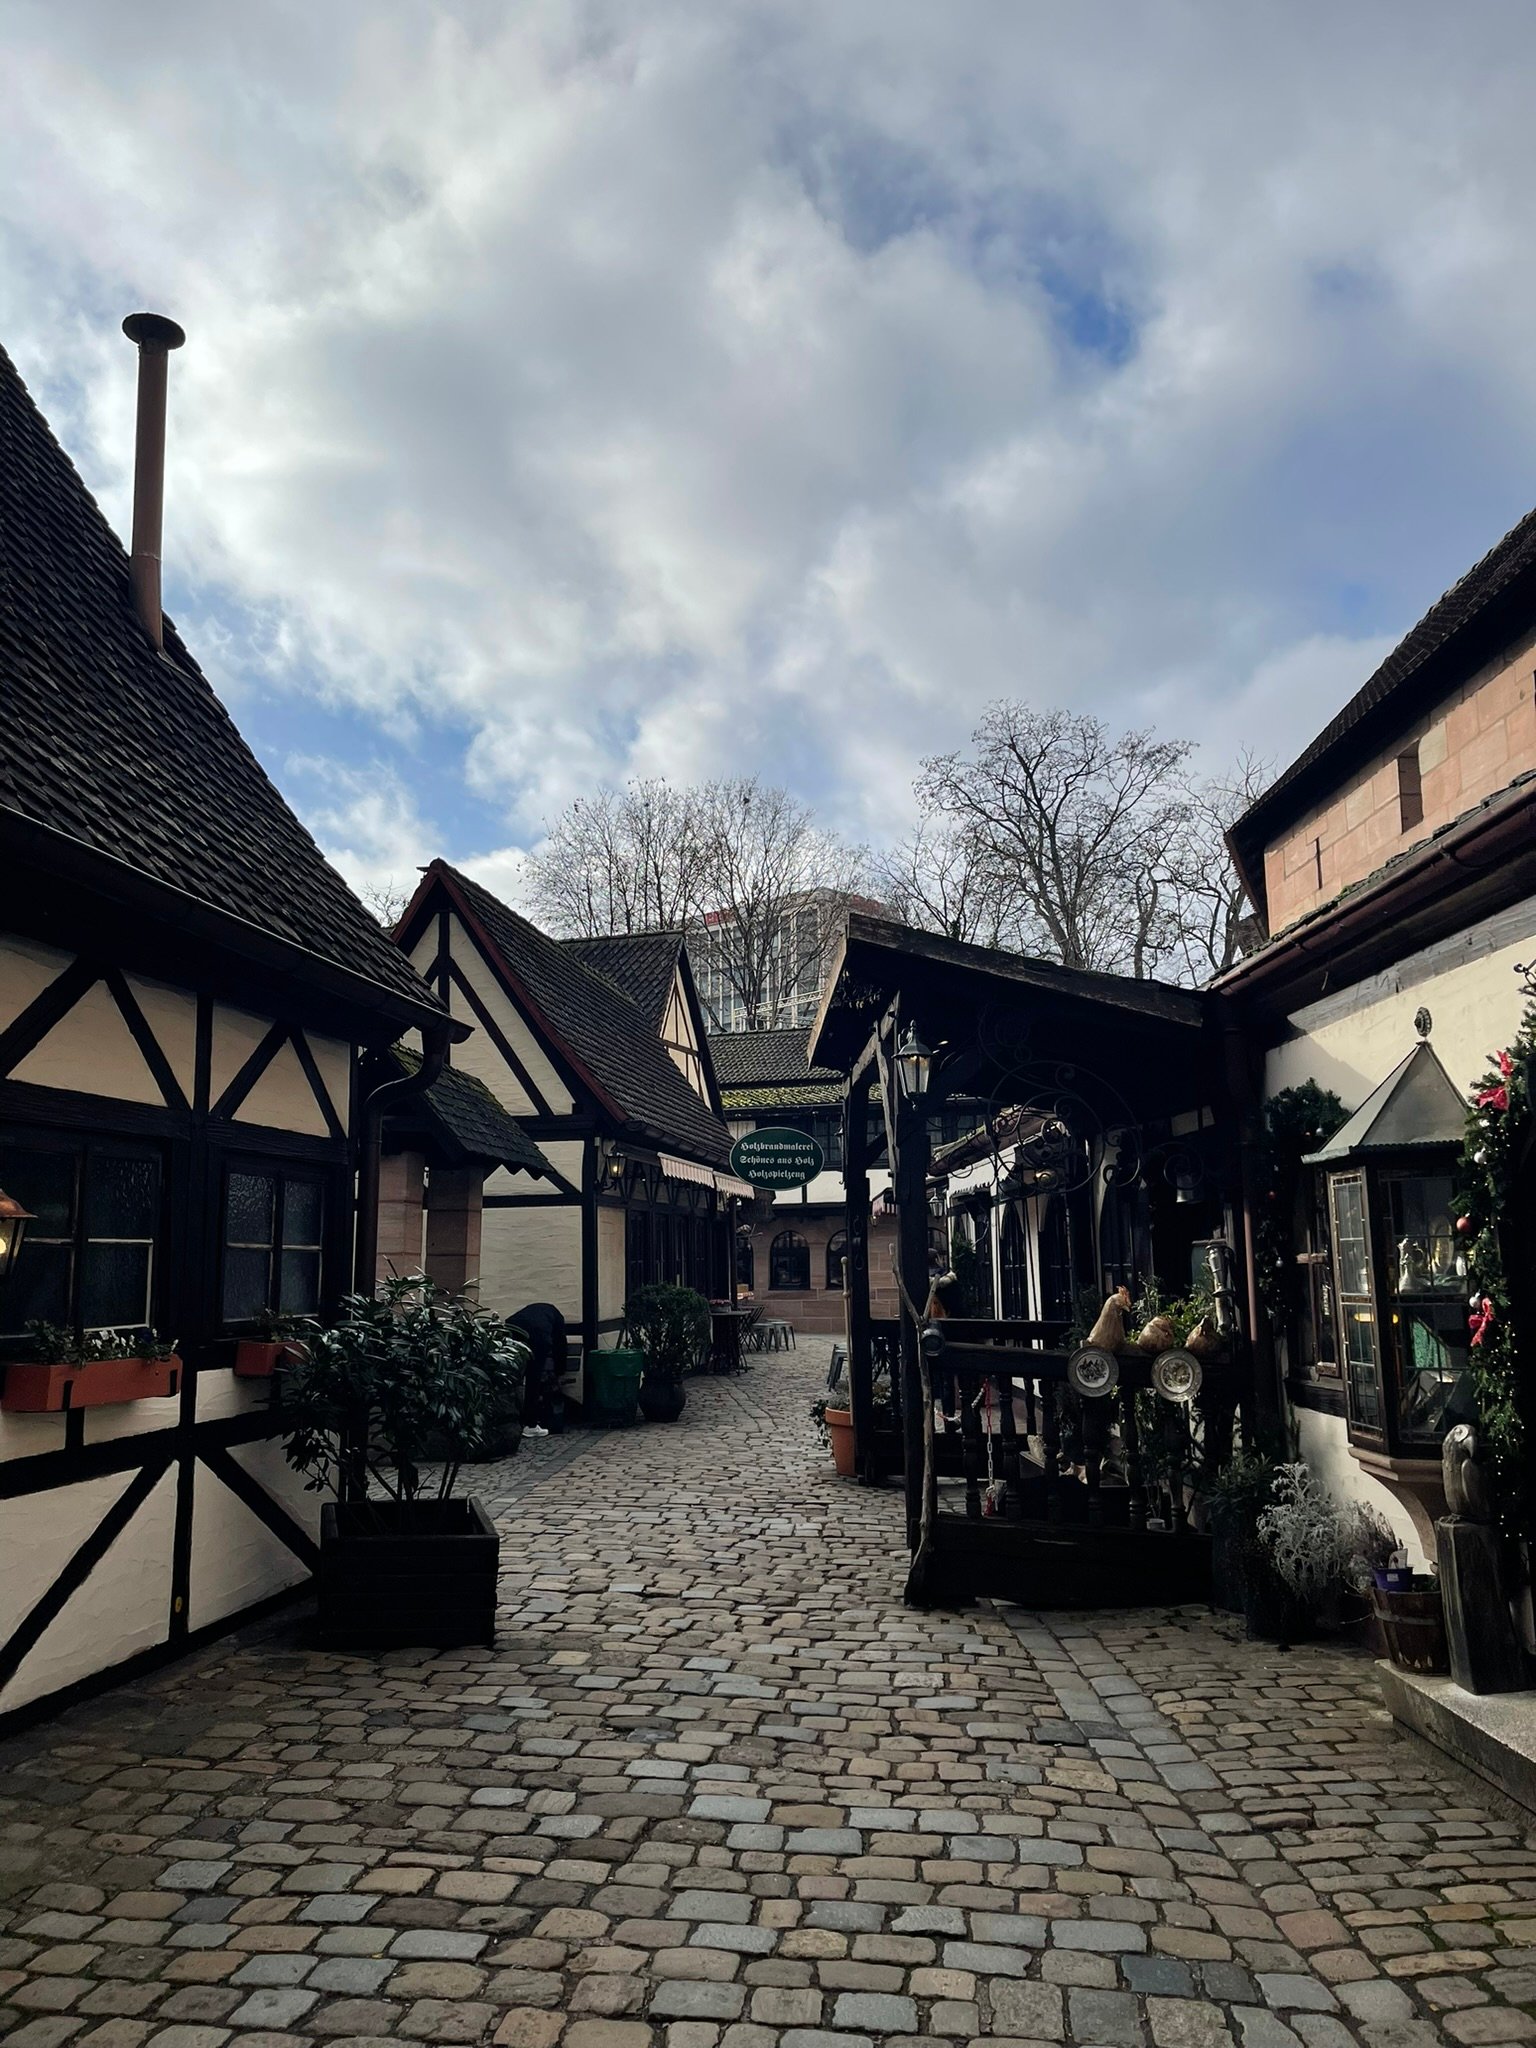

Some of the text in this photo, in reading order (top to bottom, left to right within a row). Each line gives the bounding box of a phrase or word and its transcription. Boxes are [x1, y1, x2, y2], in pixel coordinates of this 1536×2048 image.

[741, 1142, 813, 1151] Holzbrandmalerei
[740, 1155, 814, 1165] Schönes aus Holz
[748, 1169, 805, 1179] Holzspielzeug
